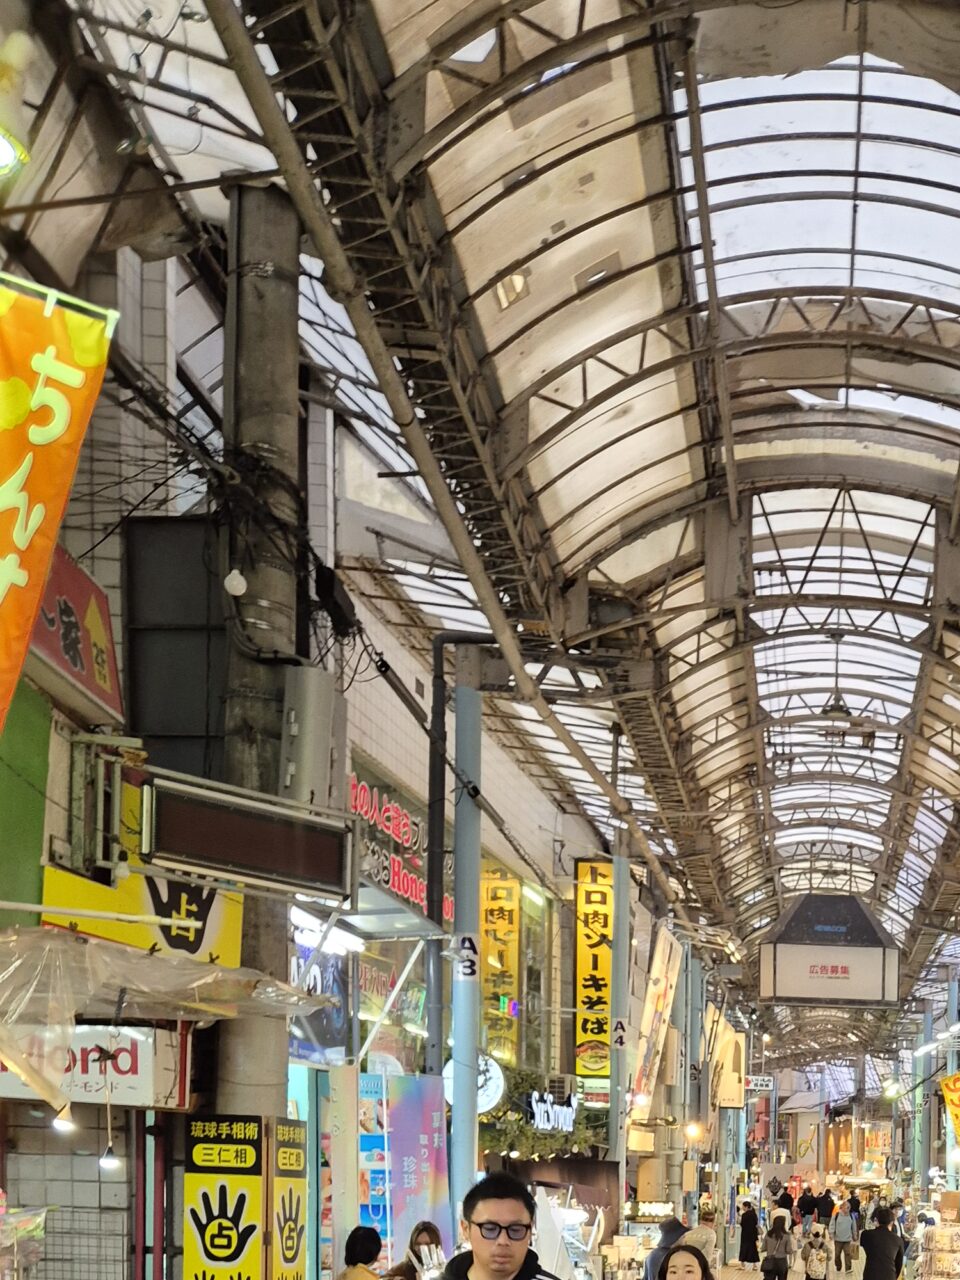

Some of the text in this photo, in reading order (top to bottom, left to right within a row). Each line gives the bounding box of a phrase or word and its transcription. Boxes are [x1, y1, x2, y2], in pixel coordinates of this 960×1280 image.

[581, 865, 611, 1035] トロ肉ソーキそば
[190, 1121, 259, 1140] 琉球手相術
[201, 1146, 247, 1164] 三仁相
[210, 1222, 234, 1249] 占
[285, 1223, 296, 1251] 占
